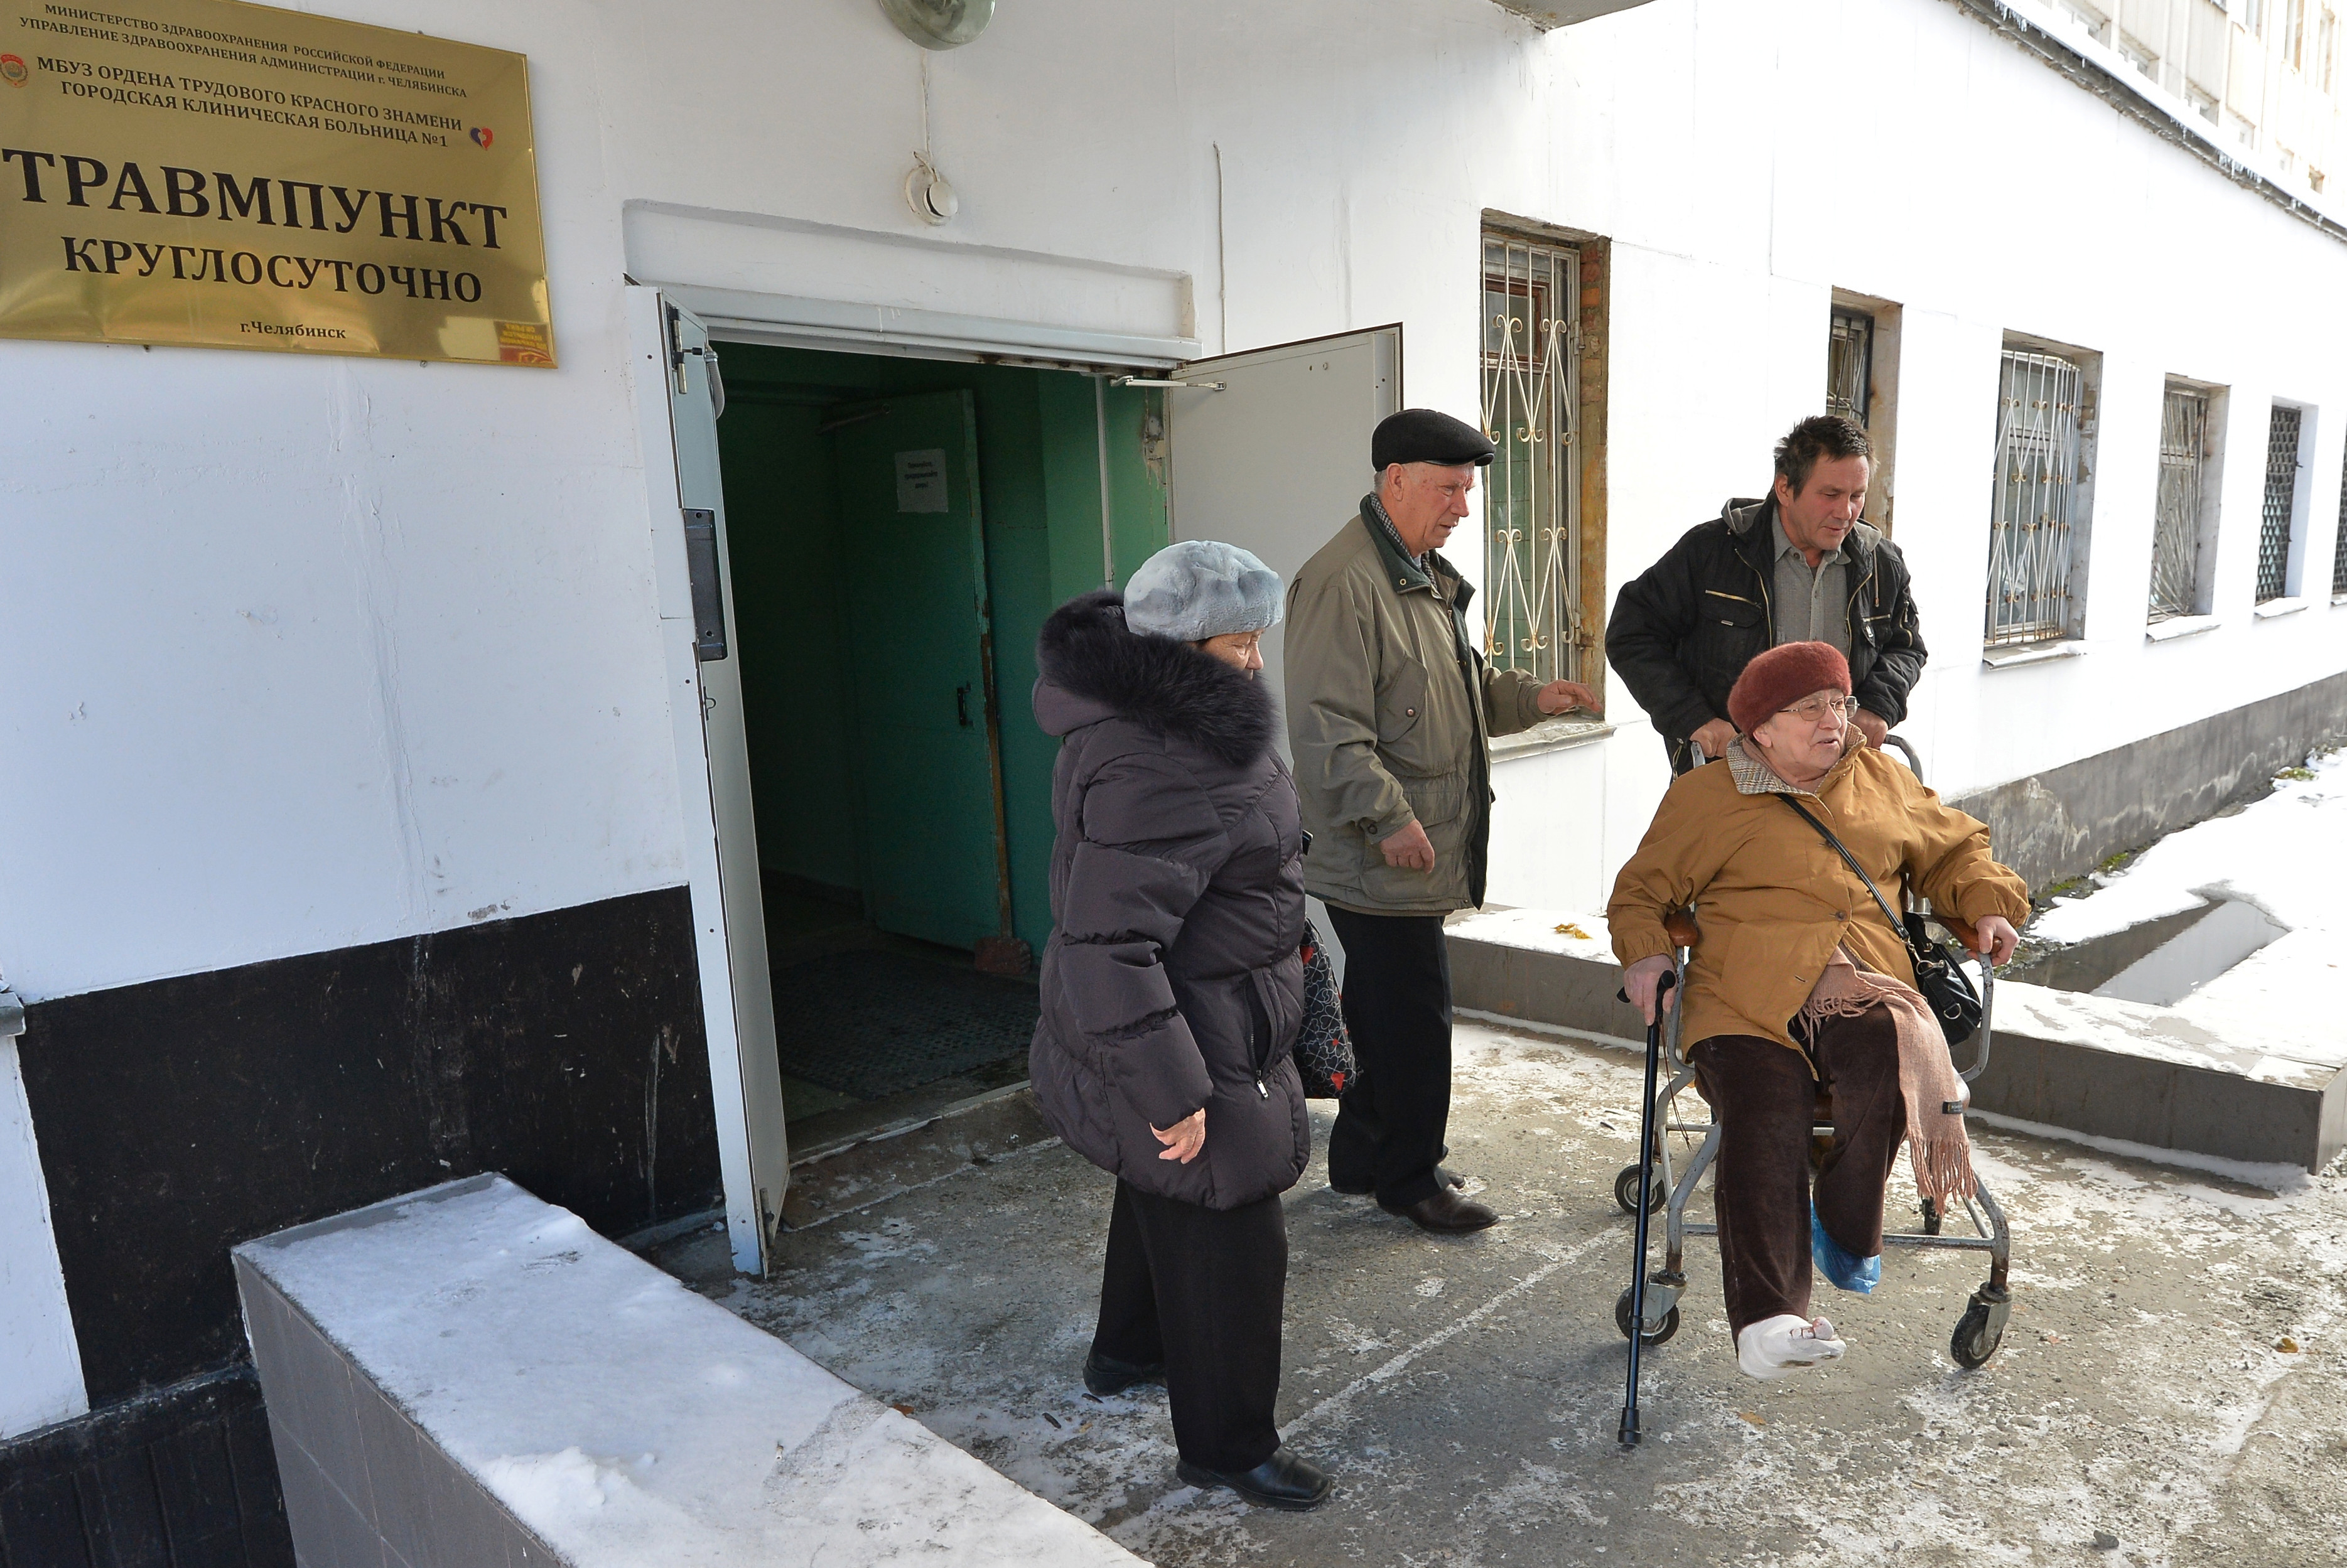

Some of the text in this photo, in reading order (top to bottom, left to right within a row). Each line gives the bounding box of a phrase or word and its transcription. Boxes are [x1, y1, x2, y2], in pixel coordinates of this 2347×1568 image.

[19, 16, 467, 98] УПРАВЛЕНИЕ ЗДРАВООХРАНЕНИЯ АДМИНИСТРАЦИИ г. ЧЕЛЯБИНСКА
[45, 4, 445, 79] МИНИСТЕРСТВО ЗДРАВООХРАНЕНИЯ РОССИЙСКОЙ ФЕДЕРАЦИИ
[36, 56, 462, 131] МБУЗ ОРДЕНА ТРУДОВОГО КРАСНОГО ЗНАМЕНИ
[61, 81, 178, 109] ГОРОДСКАЯ
[182, 97, 320, 129] КЛИНИЧЕСКАЯ
[324, 117, 418, 144] БОЛЬНИЦА
[3, 148, 507, 249] ТРАВМПУНКТ
[60, 236, 482, 303] КРУГЛОСУТОЧНО
